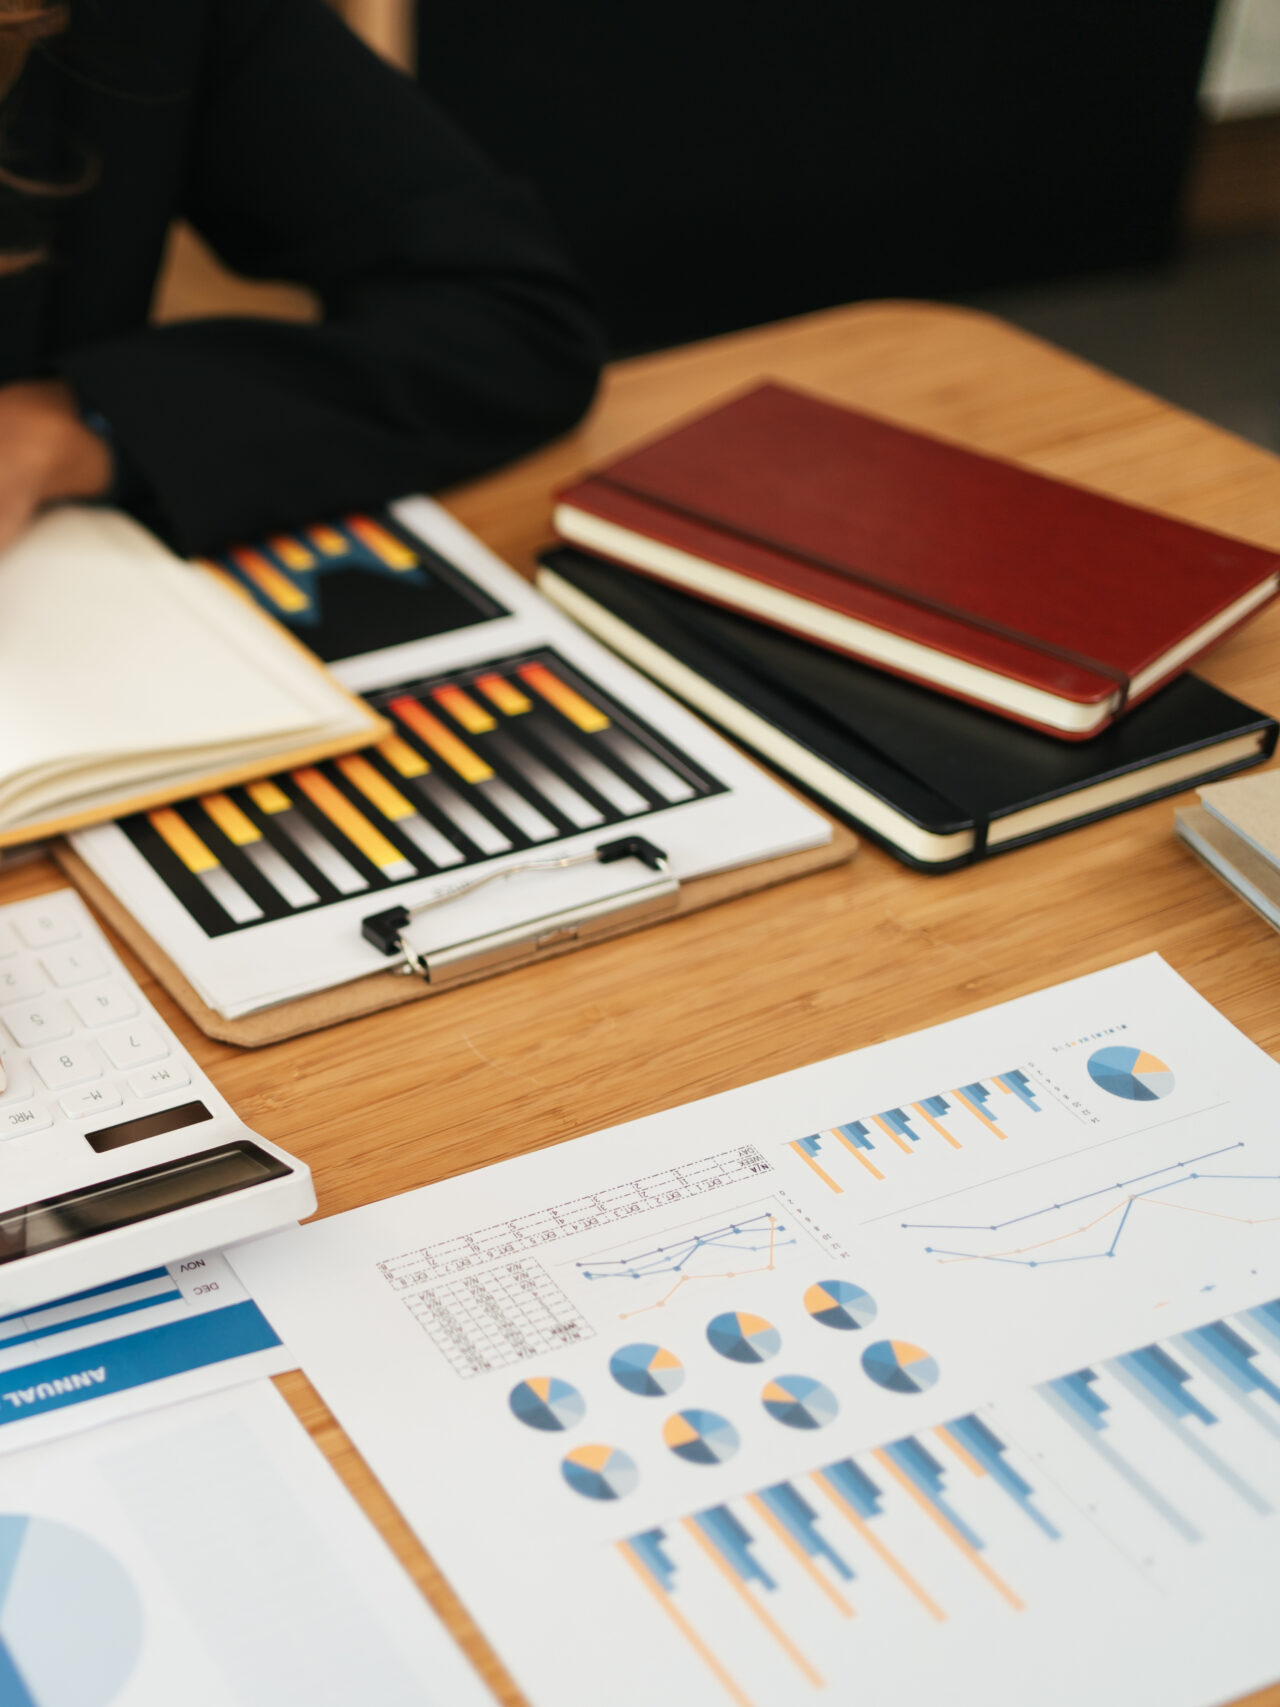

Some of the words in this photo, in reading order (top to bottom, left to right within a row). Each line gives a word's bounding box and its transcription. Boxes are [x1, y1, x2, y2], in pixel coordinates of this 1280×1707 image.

[5, 974, 16, 985] 2
[97, 996, 108, 1006] 4
[30, 1014, 44, 1026] 5
[130, 1036, 140, 1048] 7
[60, 1055, 73, 1068] 8
[152, 1070, 170, 1081] M+
[8, 1110, 34, 1124] MRC
[738, 1148, 754, 1156] DAY
[740, 1156, 761, 1166] WEEK
[750, 1163, 769, 1173] N/A
[180, 1259, 205, 1272] NOV
[193, 1282, 219, 1295] DEC
[3, 1366, 106, 1407] ANNUAL
